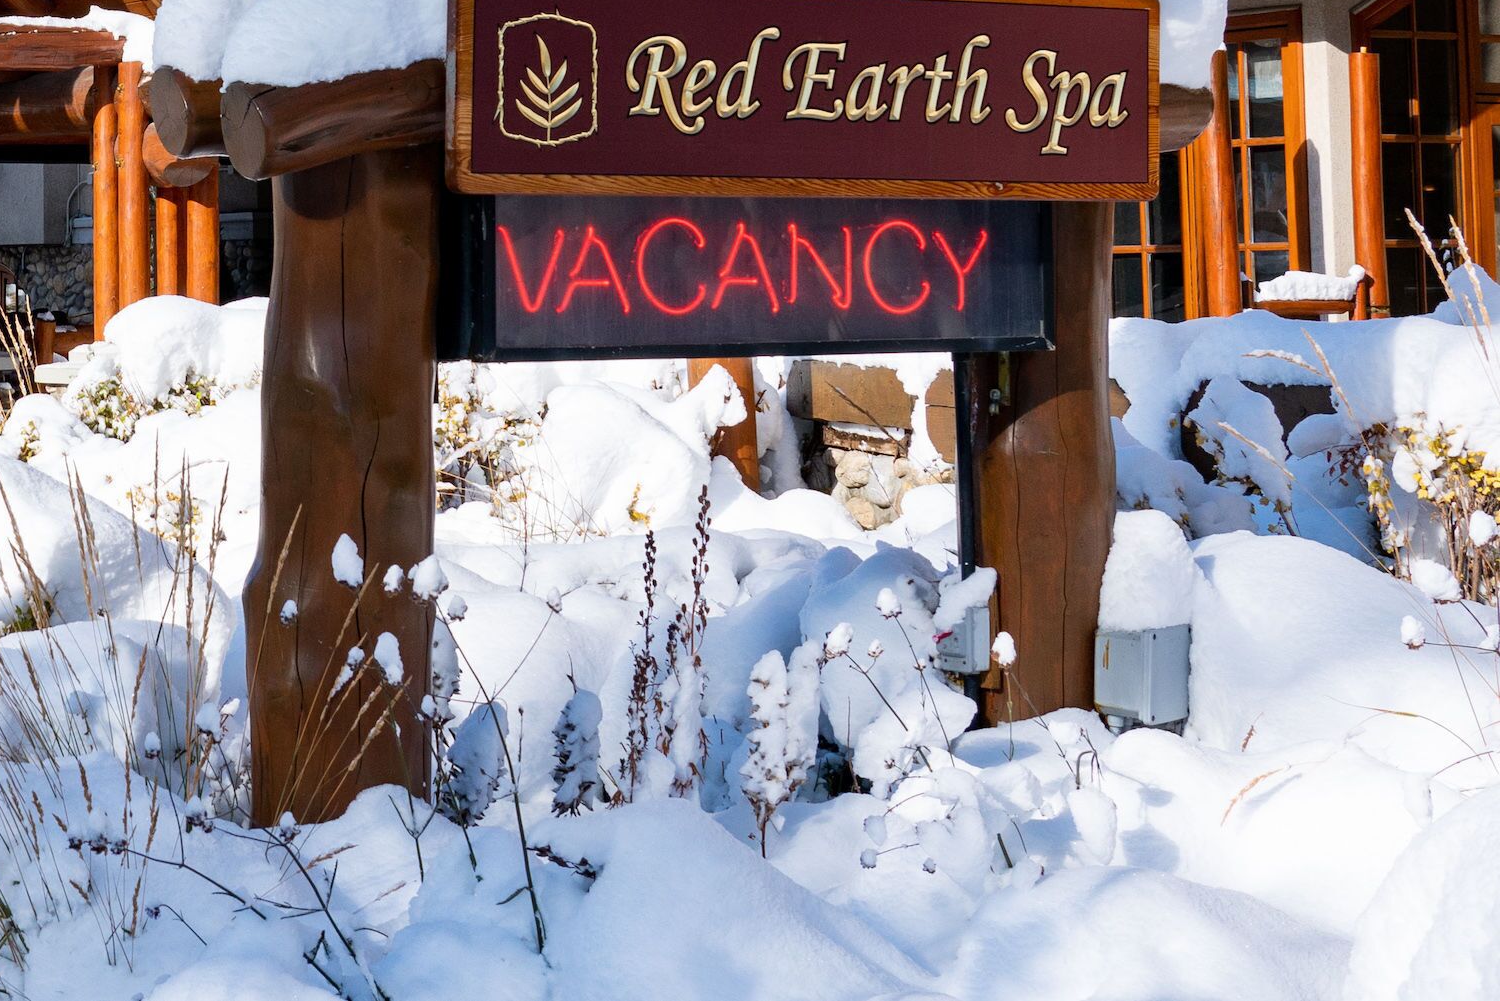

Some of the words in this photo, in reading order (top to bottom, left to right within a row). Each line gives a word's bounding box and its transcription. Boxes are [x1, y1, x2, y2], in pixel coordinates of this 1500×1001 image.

[625, 26, 781, 135] Red
[782, 34, 991, 124] Earth
[1004, 49, 1129, 156] Spa
[497, 217, 988, 315] VACANCY
